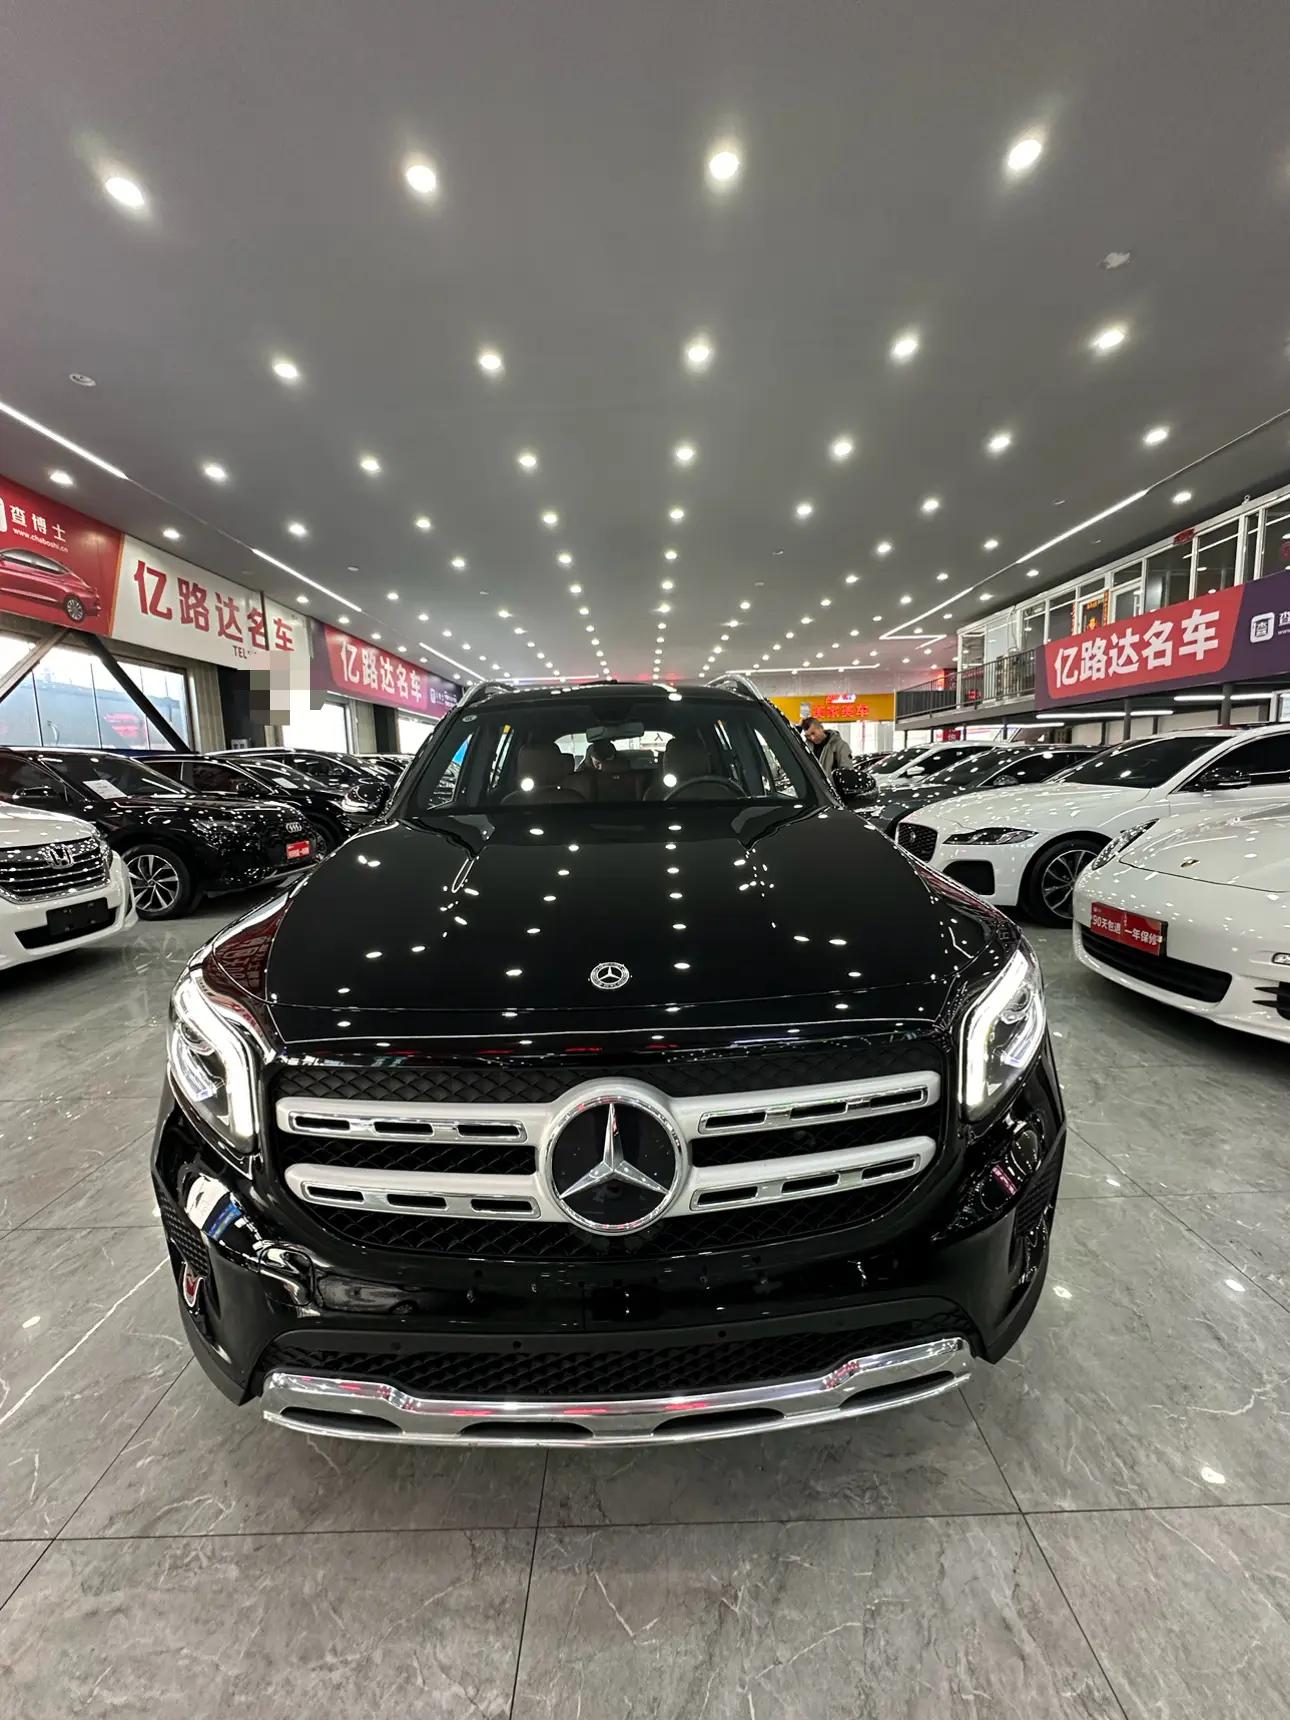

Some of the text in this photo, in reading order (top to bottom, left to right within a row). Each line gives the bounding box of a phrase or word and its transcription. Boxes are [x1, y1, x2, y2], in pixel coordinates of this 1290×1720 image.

[9, 504, 66, 542] 查博士
[133, 559, 294, 652] 亿路达名车
[340, 640, 422, 703] 亿路达名车
[1054, 608, 1220, 689] 亿路达名车
